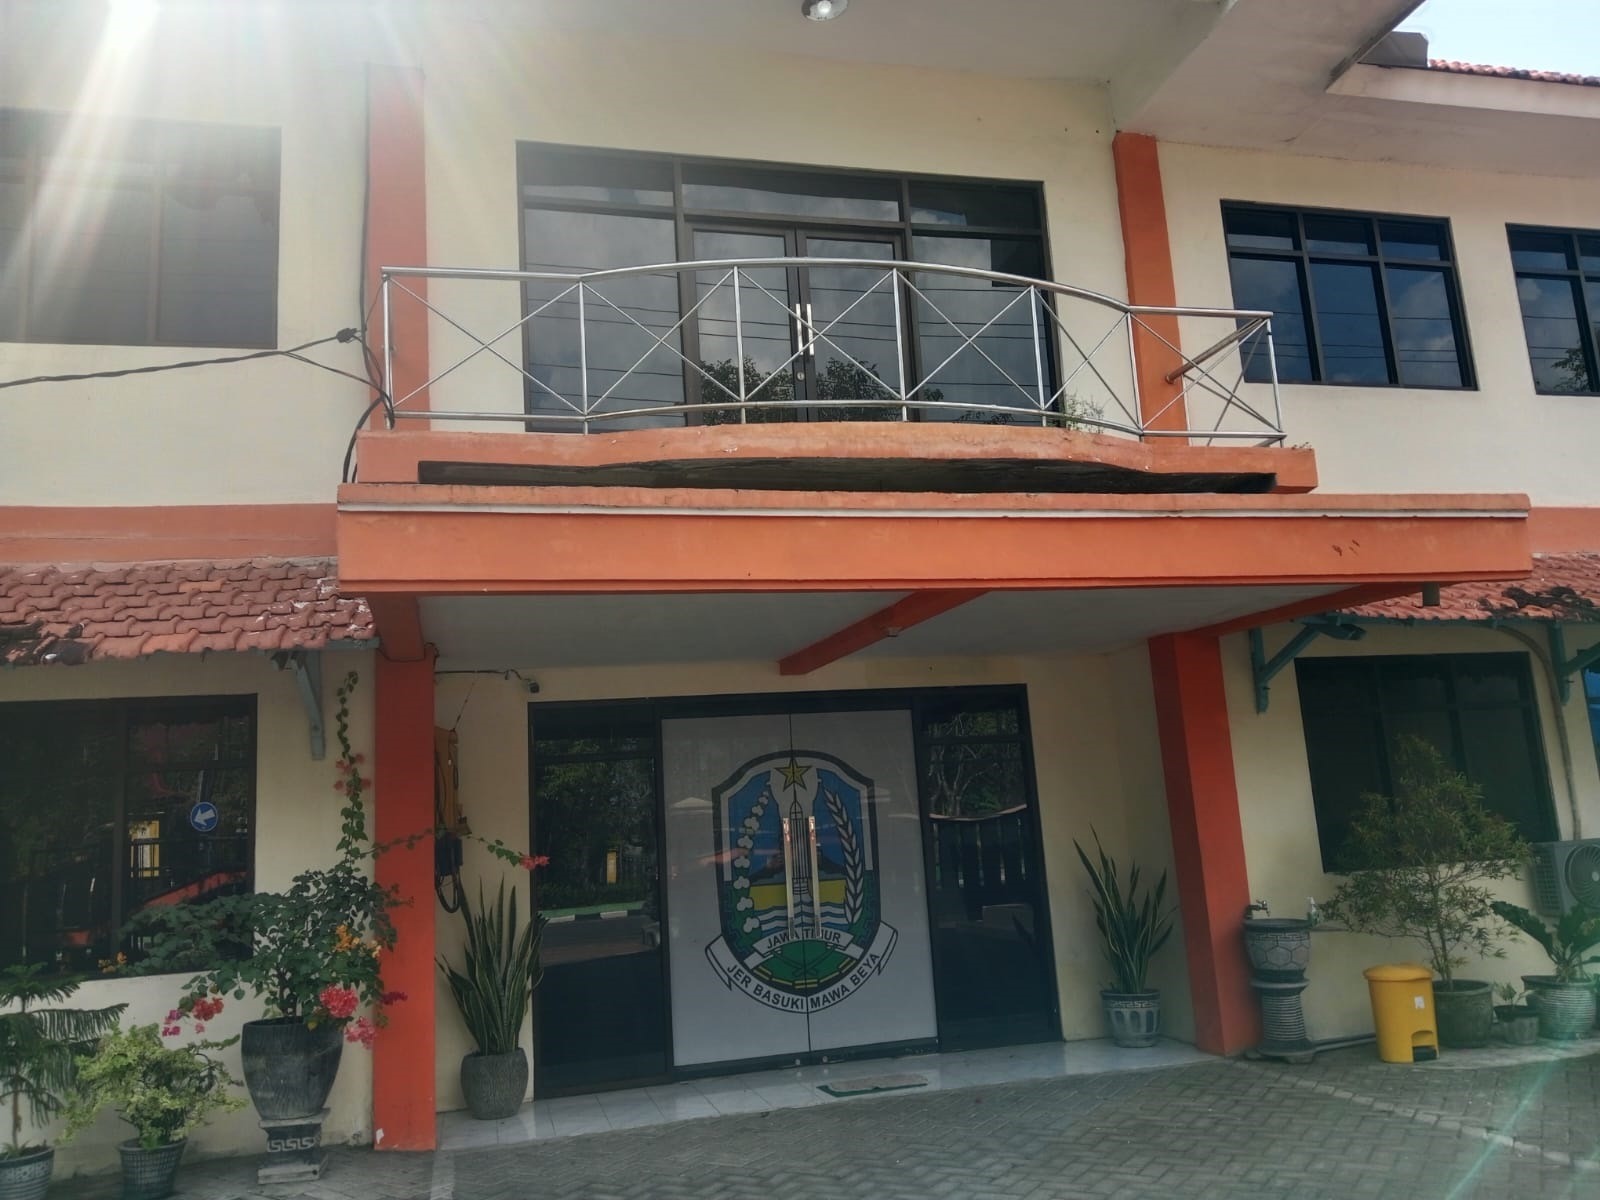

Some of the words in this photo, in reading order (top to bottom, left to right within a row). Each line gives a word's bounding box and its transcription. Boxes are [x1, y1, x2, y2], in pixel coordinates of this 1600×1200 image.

[727, 964, 750, 988] JER
[753, 984, 804, 1010] BASUKI
[810, 984, 850, 1009] MAWA
[850, 953, 880, 986] BEYA
